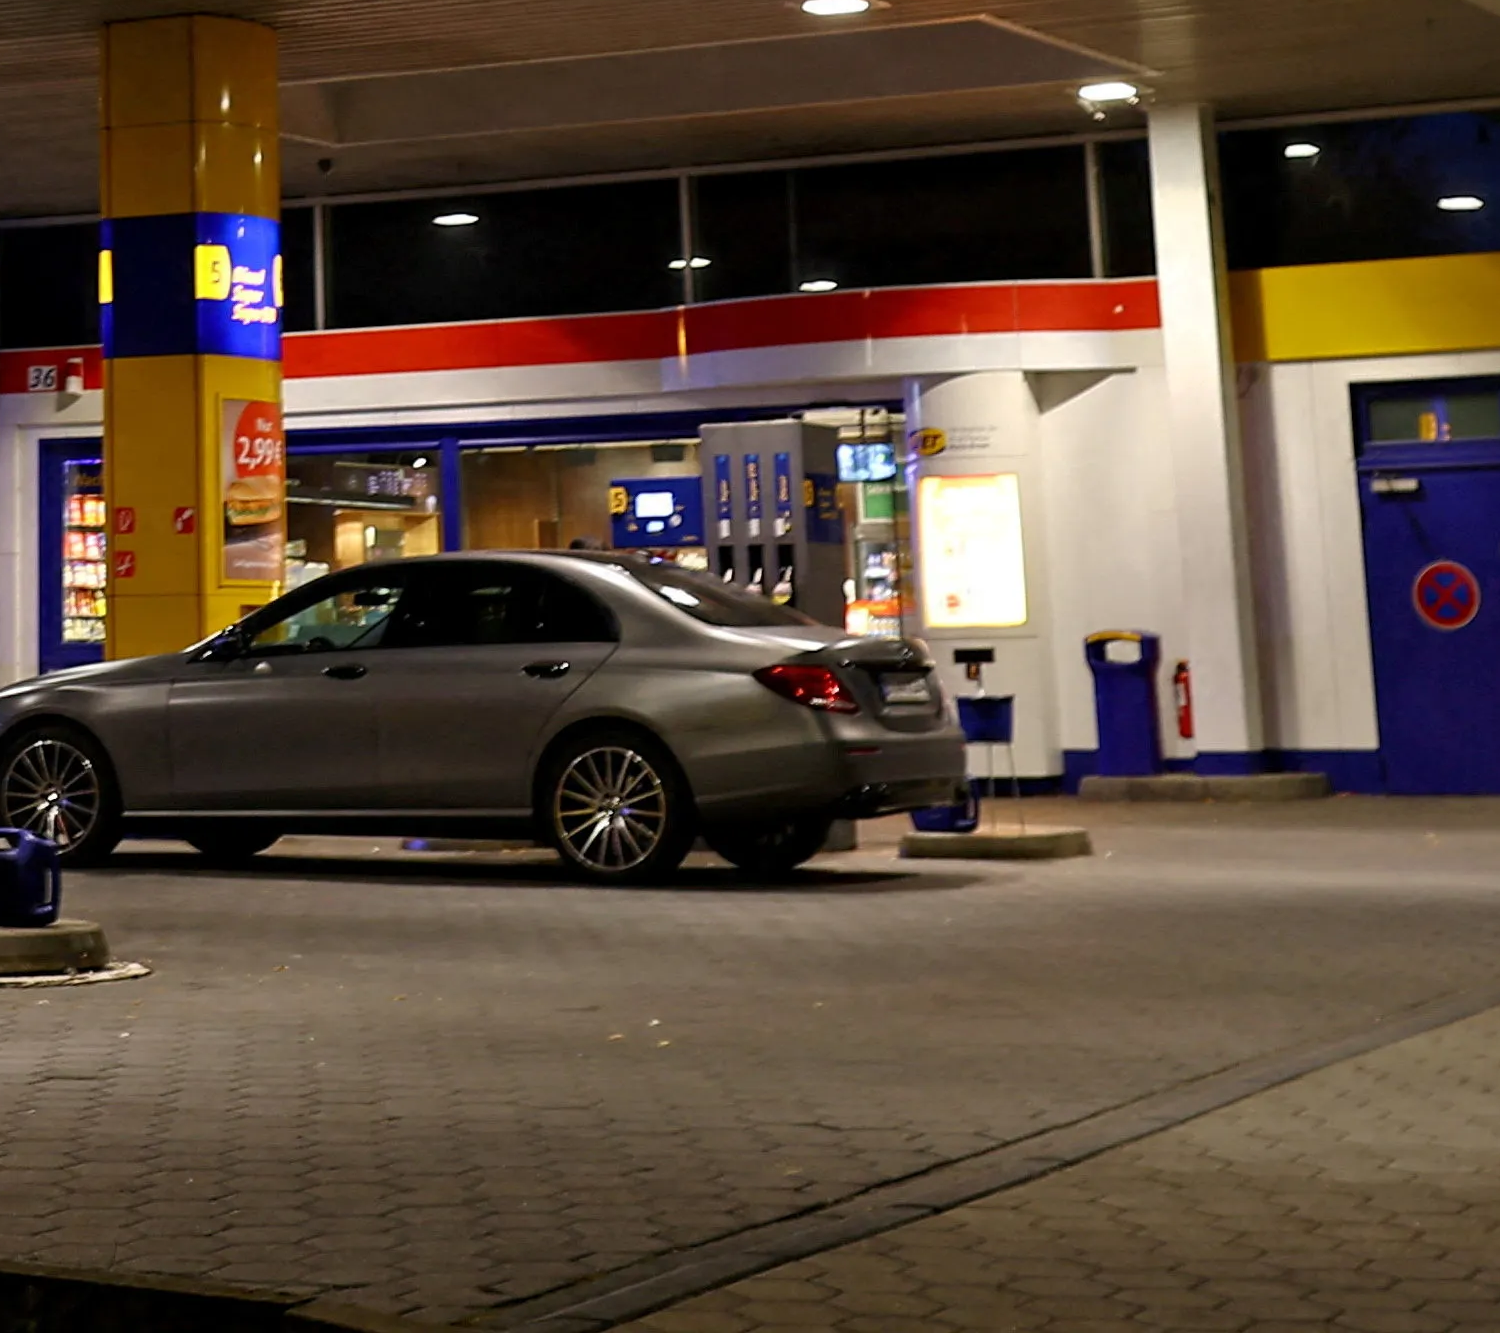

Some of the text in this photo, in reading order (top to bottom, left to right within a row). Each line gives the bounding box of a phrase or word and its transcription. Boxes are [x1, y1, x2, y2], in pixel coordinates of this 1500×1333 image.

[211, 260, 221, 284] 5
[30, 367, 57, 388] 36
[614, 491, 624, 509] 5
